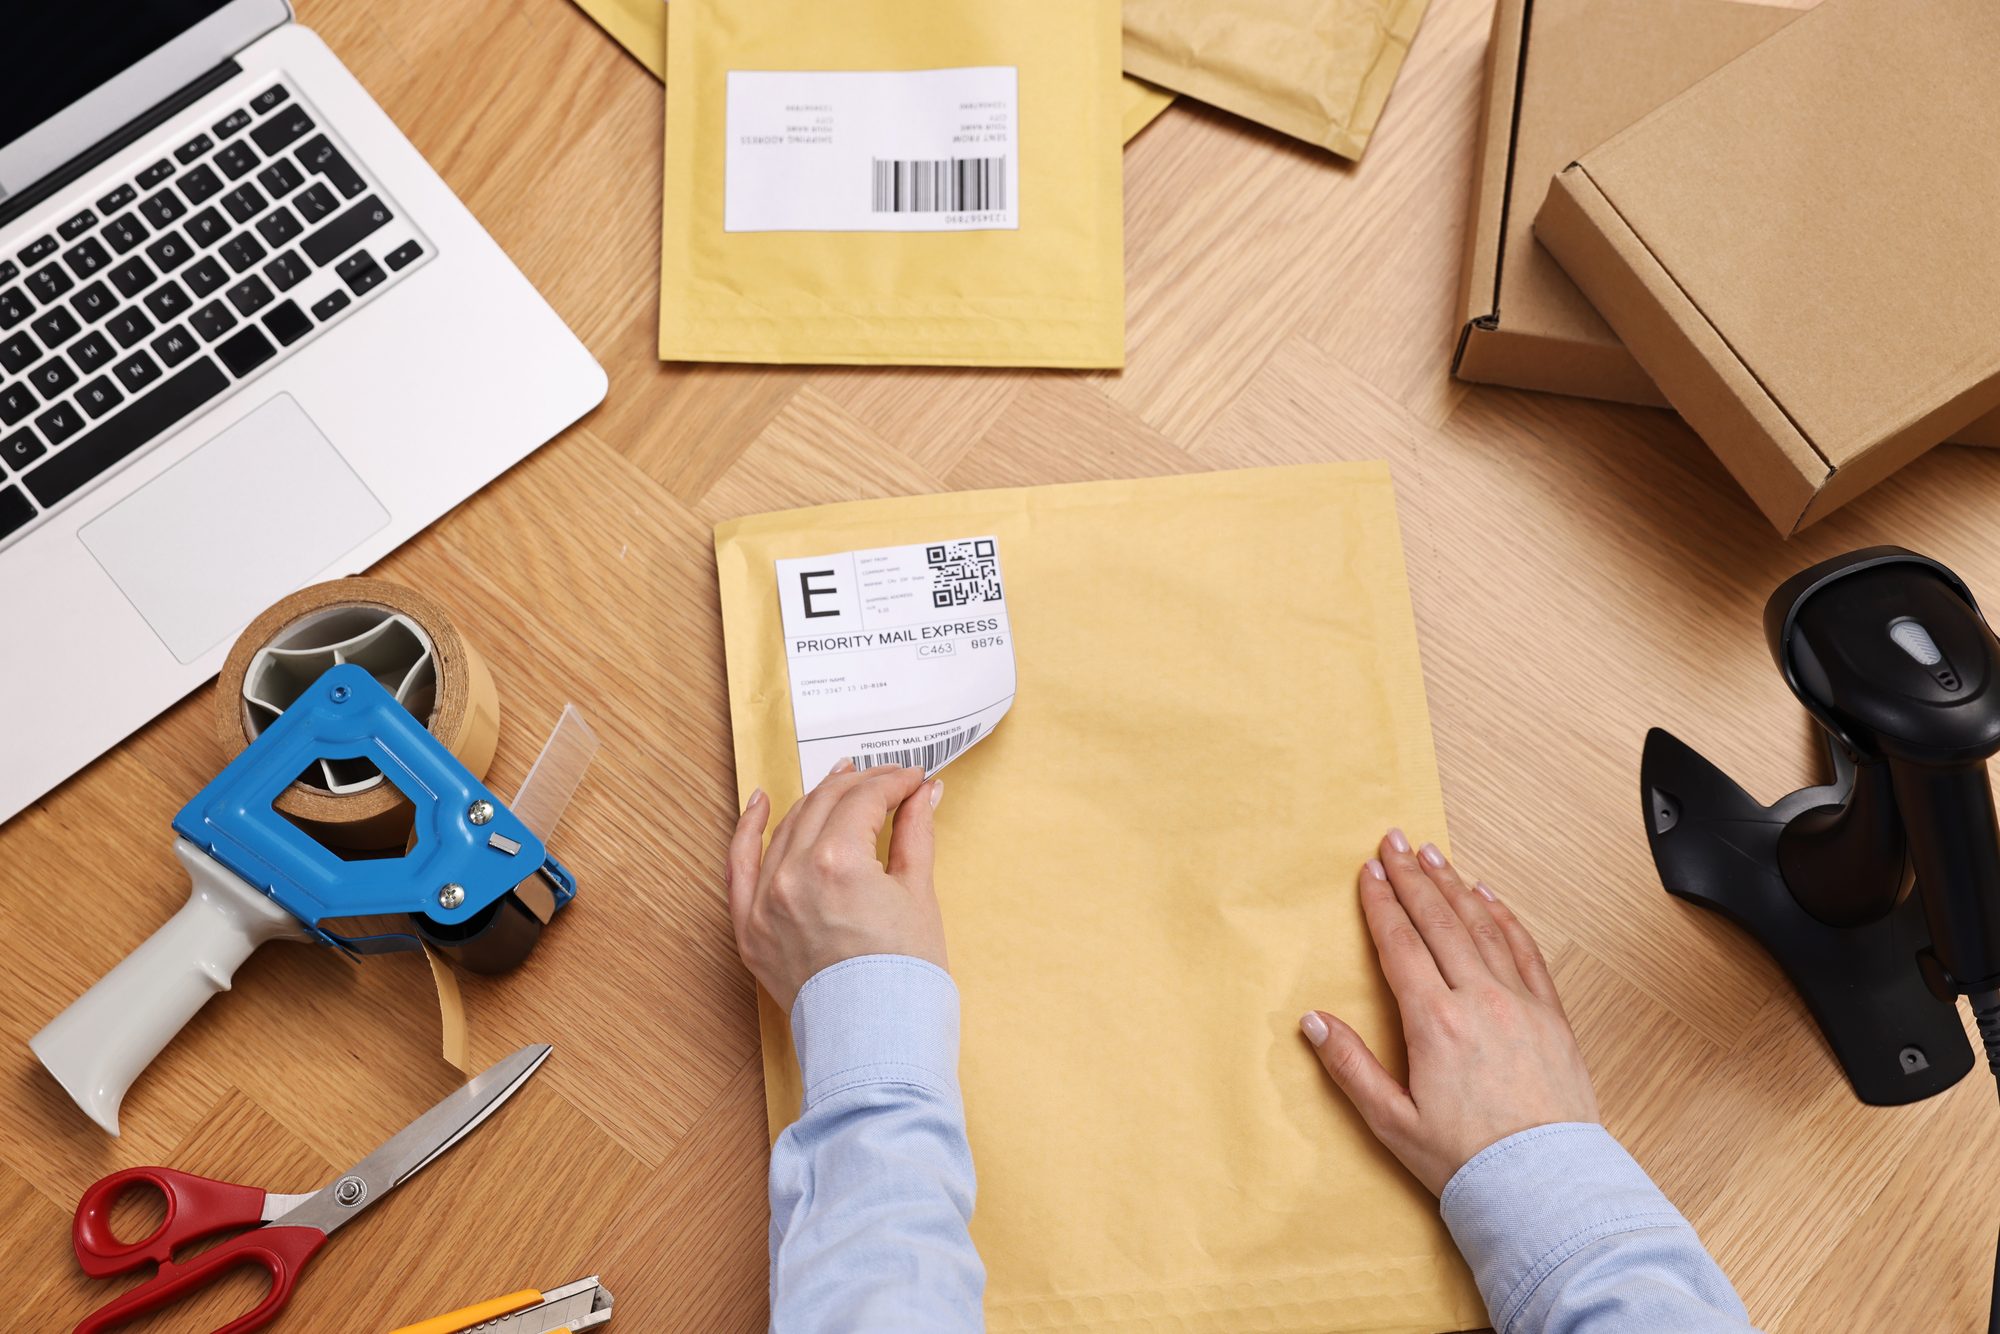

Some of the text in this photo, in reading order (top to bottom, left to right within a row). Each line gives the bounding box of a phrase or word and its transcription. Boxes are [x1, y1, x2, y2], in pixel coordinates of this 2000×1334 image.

[87, 293, 101, 308] U
[161, 293, 175, 308] K
[48, 319, 61, 331] Y
[84, 343, 99, 359] H
[130, 363, 145, 377] N
[52, 415, 65, 429] V
[15, 441, 28, 454] C
[800, 569, 840, 619] E
[796, 618, 998, 653] PRIORITY MAIL EXPRESS
[919, 642, 953, 656] C463
[860, 725, 962, 750] PRIORITY MAIL EXPRESS
